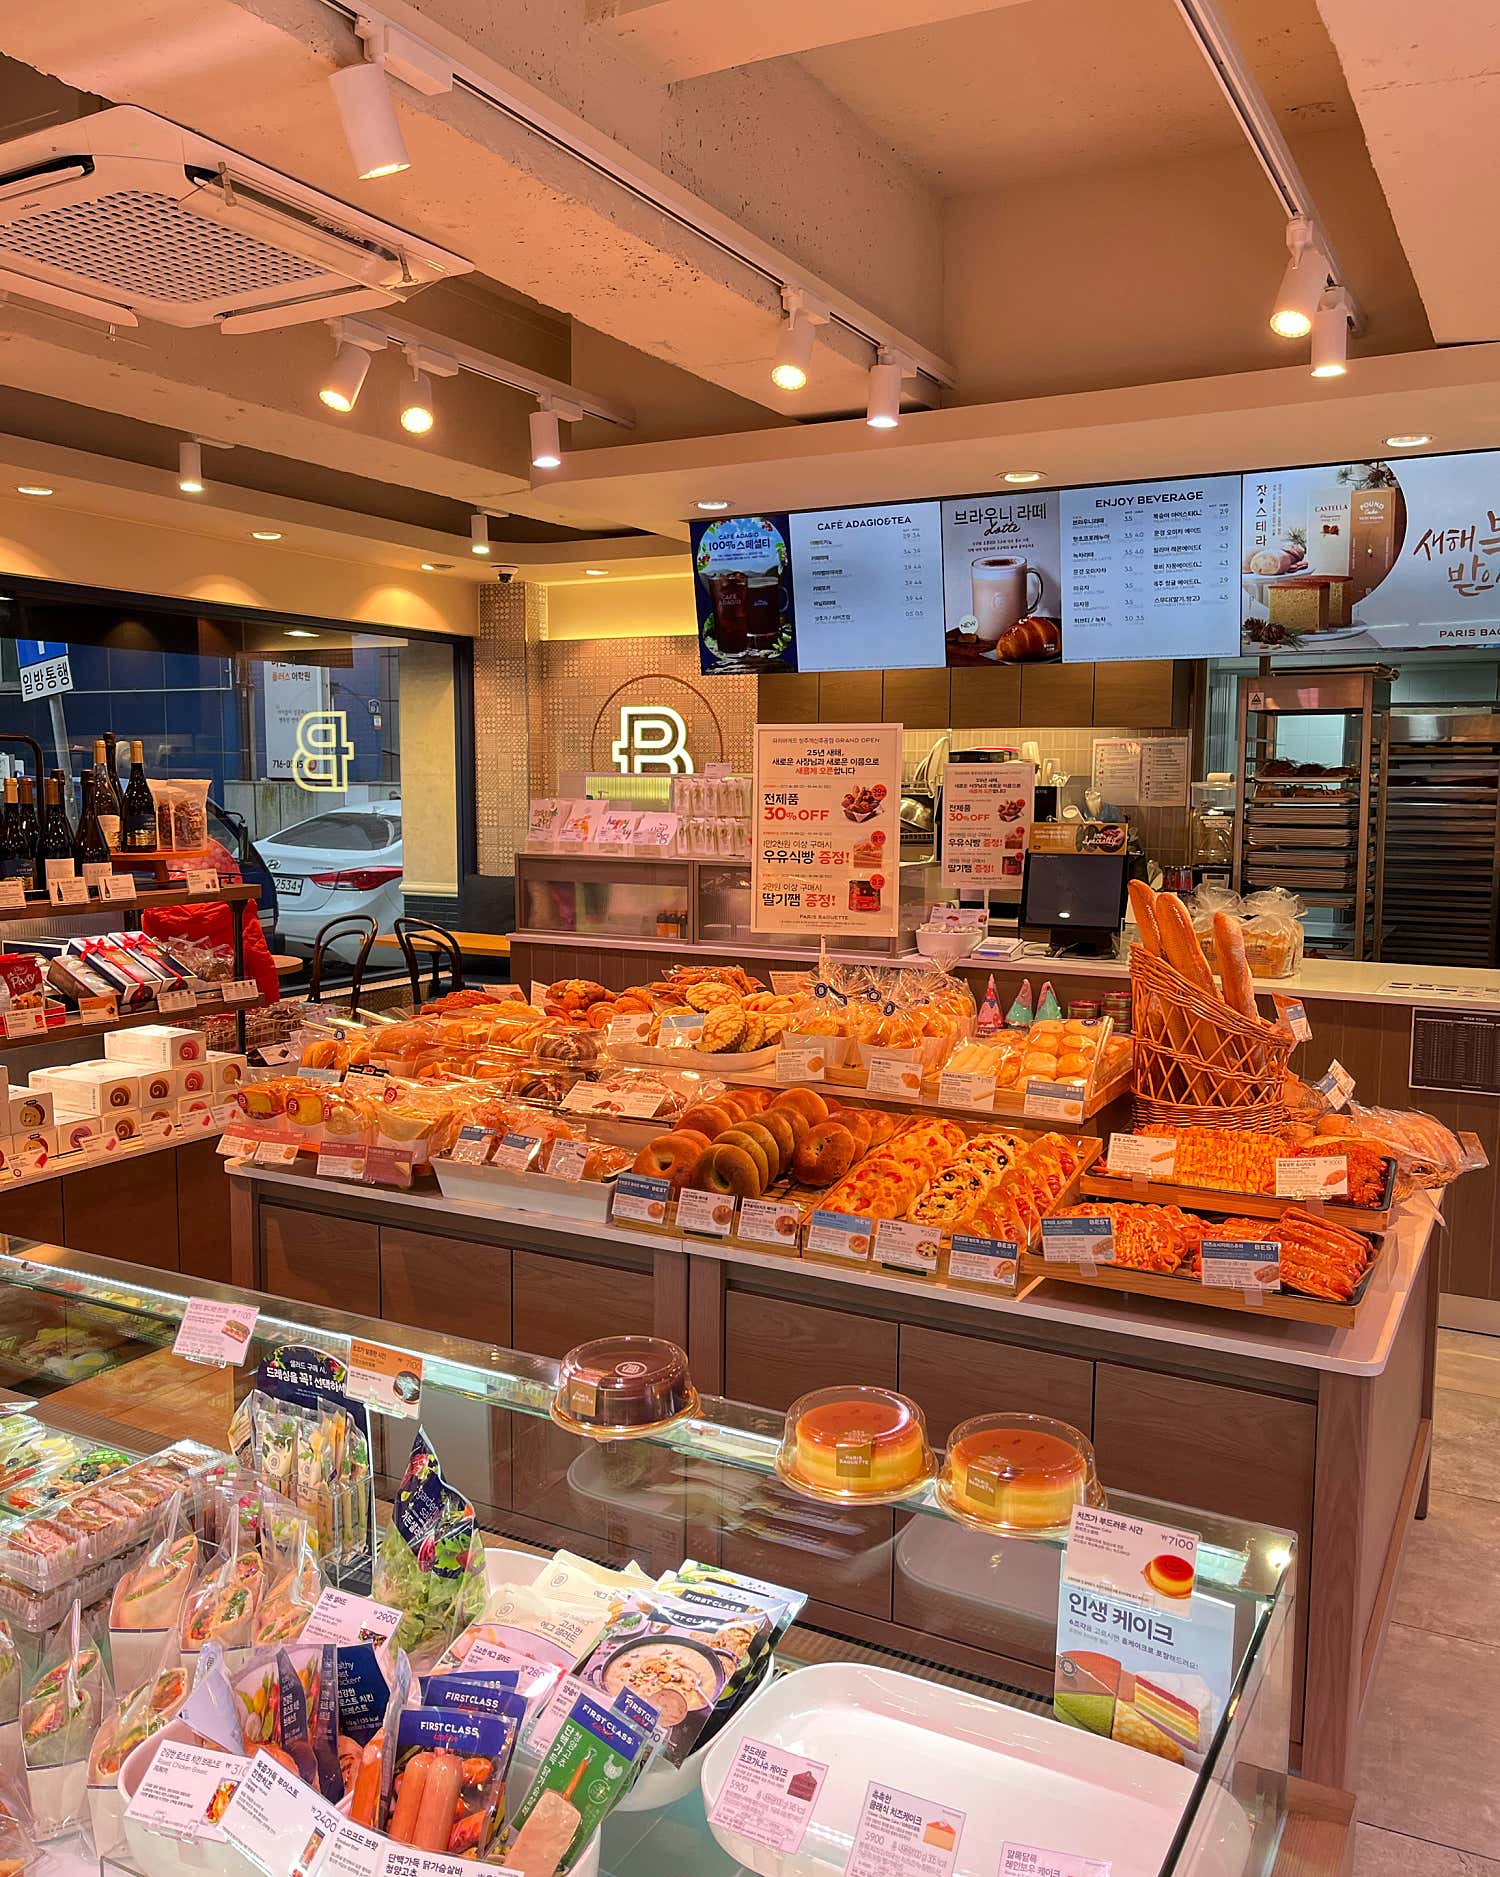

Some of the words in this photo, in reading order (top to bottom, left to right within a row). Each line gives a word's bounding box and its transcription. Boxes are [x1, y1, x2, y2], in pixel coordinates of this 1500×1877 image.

[1095, 497, 1134, 508] ENJOY
[1137, 491, 1203, 504] BEVERAGE
[954, 505, 1013, 525] 브라우니
[1017, 503, 1047, 520] 라떼
[1315, 504, 1348, 513] CASTELLA
[817, 520, 843, 531] CAFÉ
[845, 516, 912, 528] ADAGIO&TEA
[984, 521, 1021, 536] Latte
[1413, 525, 1475, 561] 새해
[1448, 554, 1500, 596] 받으
[1439, 629, 1476, 638] PARIS
[22, 661, 70, 695] 일방통행
[292, 672, 311, 681] 어학원
[827, 749, 845, 757] 새해,
[772, 758, 794, 766] 새로운
[827, 758, 848, 766] 새로운
[851, 758, 880, 766] 이름으로
[764, 793, 799, 806] 전제품
[949, 804, 971, 812] 전제품
[763, 840, 791, 848] 1만2천원
[793, 840, 808, 848] 이상
[810, 840, 832, 849] 구매시
[948, 839, 981, 847] 우유식빵
[984, 839, 1002, 847] 증정!
[763, 850, 815, 864] 우유식빵
[819, 850, 850, 865] 증정!
[948, 864, 972, 873] 딸기쨈
[975, 864, 994, 873] 증정!
[276, 878, 296, 890] 2534
[784, 883, 798, 892] 이상
[800, 884, 822, 892] 구매시
[762, 893, 800, 907] 딸기쨈
[805, 893, 836, 908] 증정!
[290, 1360, 306, 1370] 샐러드
[307, 1363, 318, 1372] 구매
[266, 1367, 299, 1384] 드레싱을
[300, 1372, 313, 1386] 꼭!
[1077, 1511, 1098, 1523] 치즈가
[1099, 1516, 1128, 1531] 부드러운
[1129, 1525, 1143, 1536] 시간
[686, 1593, 711, 1605] FIRST
[712, 1600, 742, 1613] CLASS
[1069, 1593, 1107, 1623] 인생
[1112, 1608, 1174, 1646] 케이크
[540, 1620, 555, 1631] 에그
[555, 1628, 578, 1645] 샐러드
[559, 1620, 583, 1636] 고소한
[360, 1693, 374, 1702] 치킨
[445, 1692, 469, 1703] FIRST
[470, 1696, 499, 1708] CLASS
[420, 1721, 444, 1731] FIRST
[445, 1723, 479, 1736] CLASS
[582, 1704, 606, 1725] FIRST
[606, 1722, 634, 1745] CLASS
[161, 1748, 176, 1758] 건강한
[176, 1751, 192, 1762] 로스트
[192, 1753, 202, 1765] 치킨
[743, 1744, 767, 1760] 부드러운
[171, 1762, 191, 1771] Chicken
[257, 1760, 278, 1779] 육즙가득
[738, 1754, 769, 1771] 초코가나슈
[770, 1765, 789, 1778] 케이크
[890, 1807, 922, 1826] 치즈케이크
[339, 1827, 365, 1845] 스모크드
[864, 1831, 885, 1845] 5900
[385, 1864, 417, 1877] 청양고추
[388, 1853, 420, 1868] 단백가득
[422, 1860, 463, 1876] 닭가슴살바
[1037, 1866, 1060, 1877] 케이크
